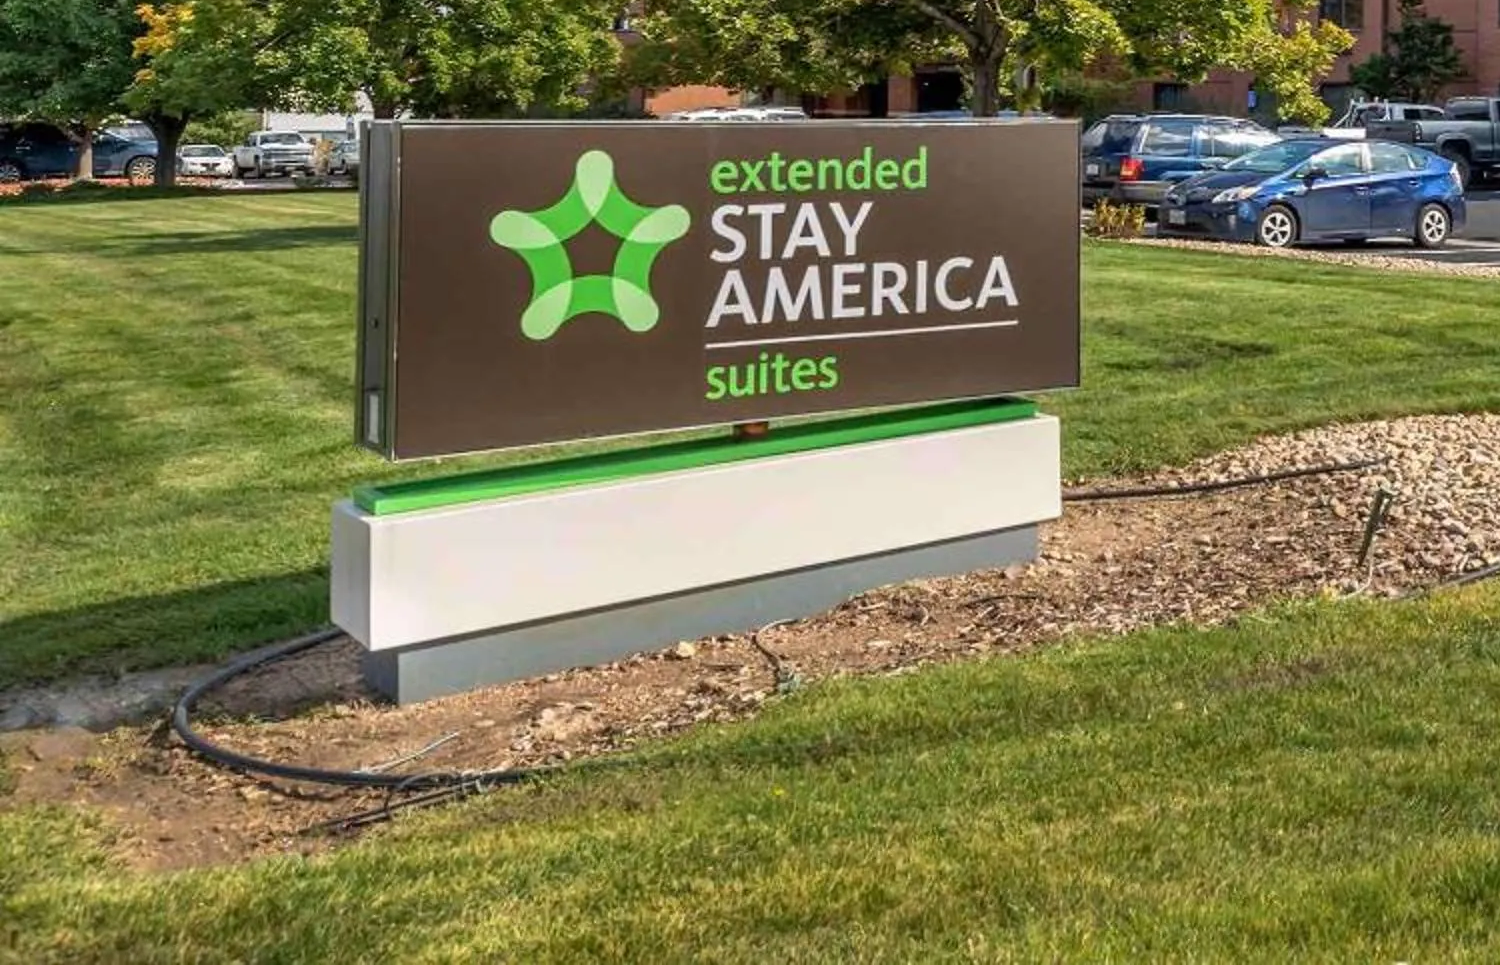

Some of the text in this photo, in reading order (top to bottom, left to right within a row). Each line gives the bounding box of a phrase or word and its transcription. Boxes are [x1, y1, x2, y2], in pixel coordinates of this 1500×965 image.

[711, 146, 928, 193] extended
[710, 201, 873, 263] STAY
[705, 255, 1020, 328] AMERICA
[706, 352, 838, 399] suites
